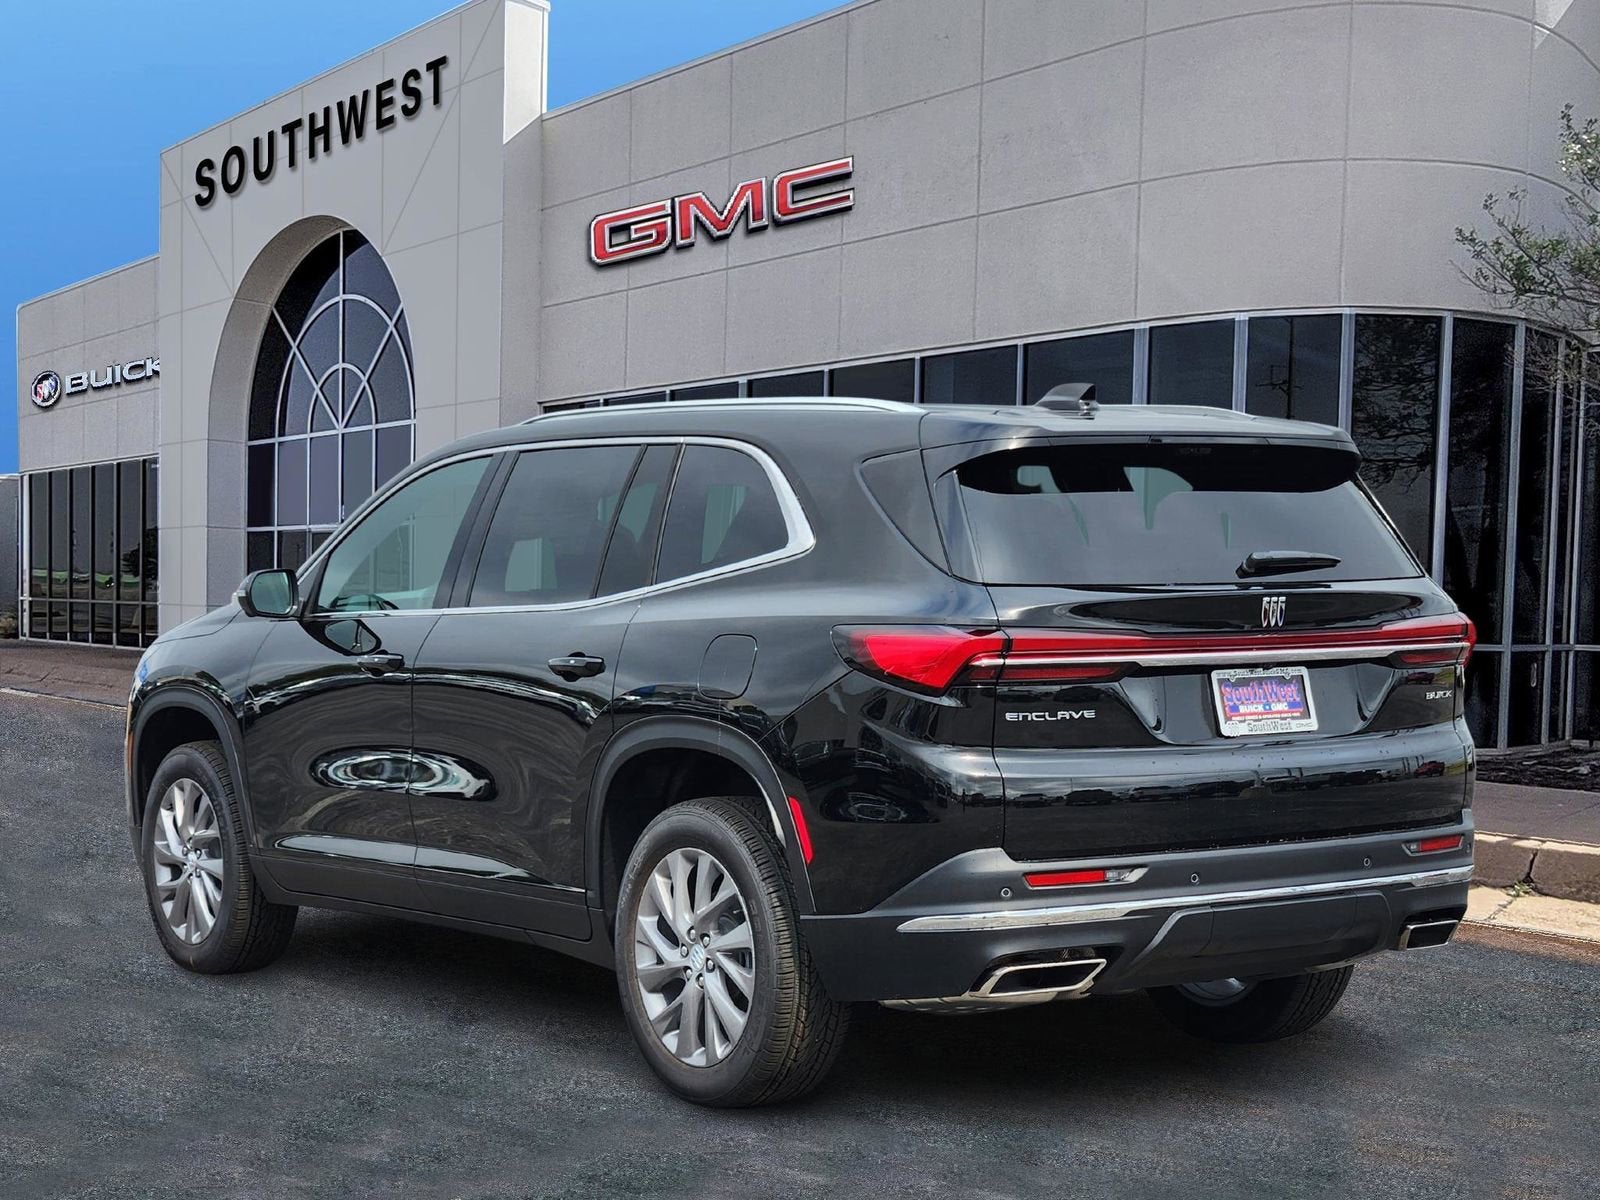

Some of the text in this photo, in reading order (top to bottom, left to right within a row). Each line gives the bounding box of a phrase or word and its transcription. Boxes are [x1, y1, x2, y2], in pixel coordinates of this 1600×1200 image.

[194, 55, 449, 208] SOUTHWEST
[588, 155, 855, 266] GMC
[65, 357, 161, 395] BUICK
[1221, 680, 1301, 706] SouthWest
[1426, 690, 1452, 699] BUICK
[1005, 710, 1096, 721] ENCLAVE
[1239, 702, 1288, 713] BUICK GMC
[1247, 720, 1293, 733] SouthWest
